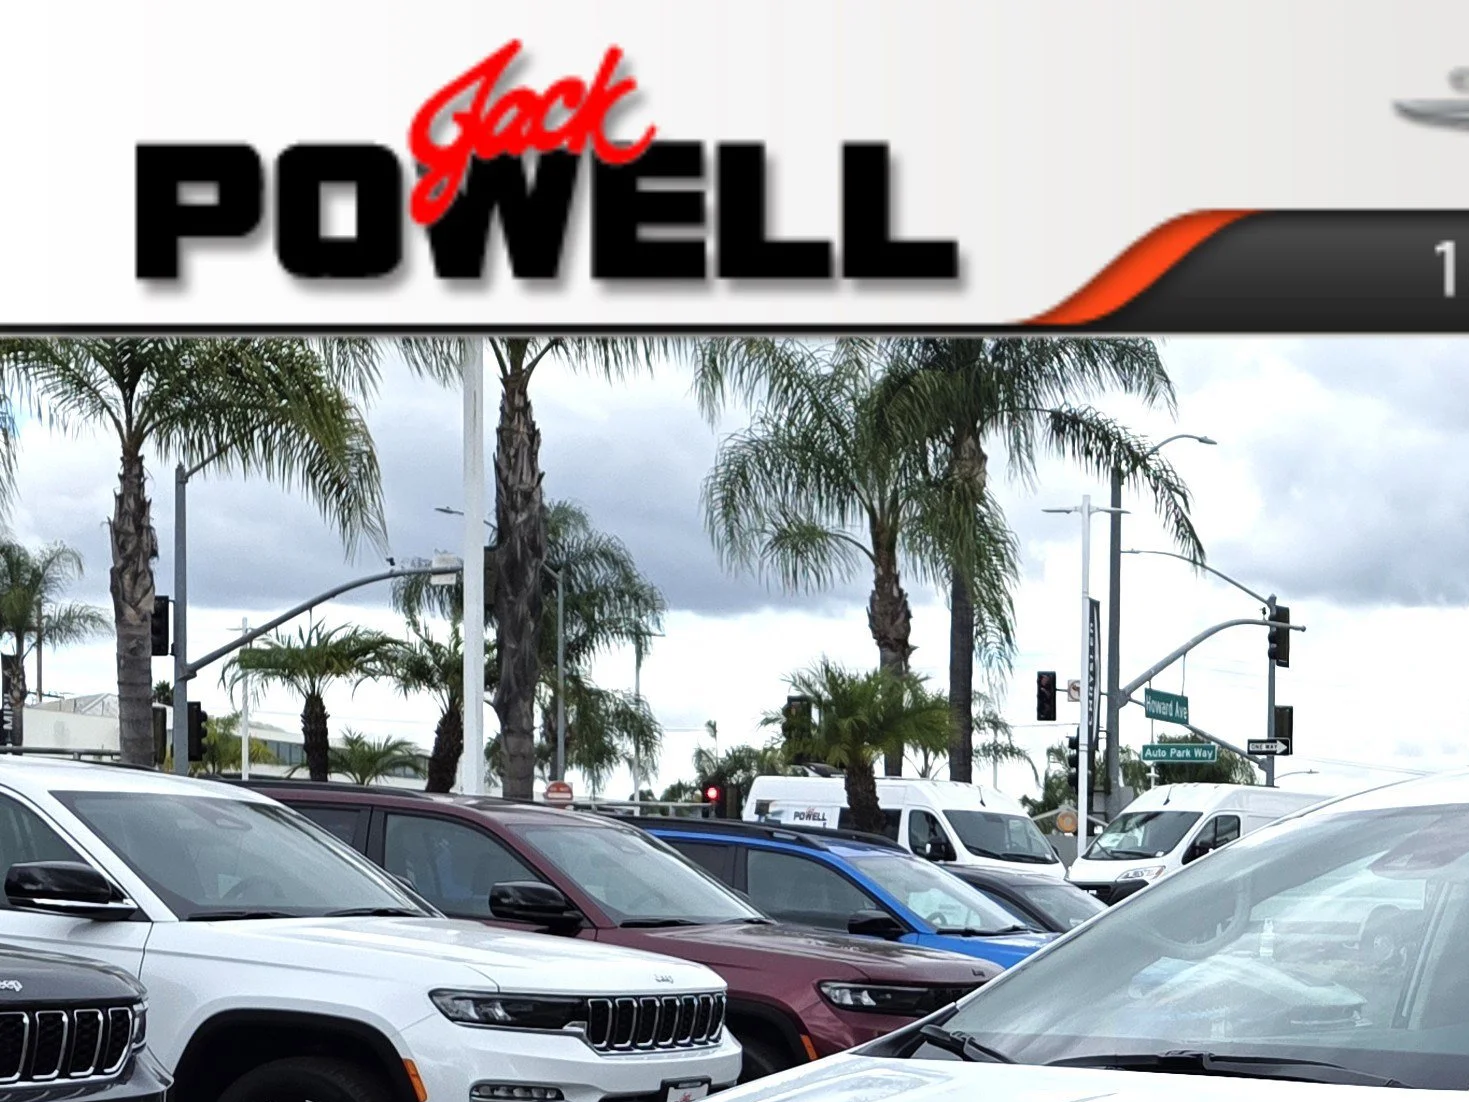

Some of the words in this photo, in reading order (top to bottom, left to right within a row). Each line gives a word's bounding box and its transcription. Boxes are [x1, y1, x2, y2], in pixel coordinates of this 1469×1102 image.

[1146, 695, 1173, 717] Howard
[1175, 701, 1188, 719] Ave
[1145, 748, 1167, 758] Auto
[1170, 748, 1191, 758] Park
[1194, 748, 1214, 760] Way
[793, 811, 827, 821] POWELL
